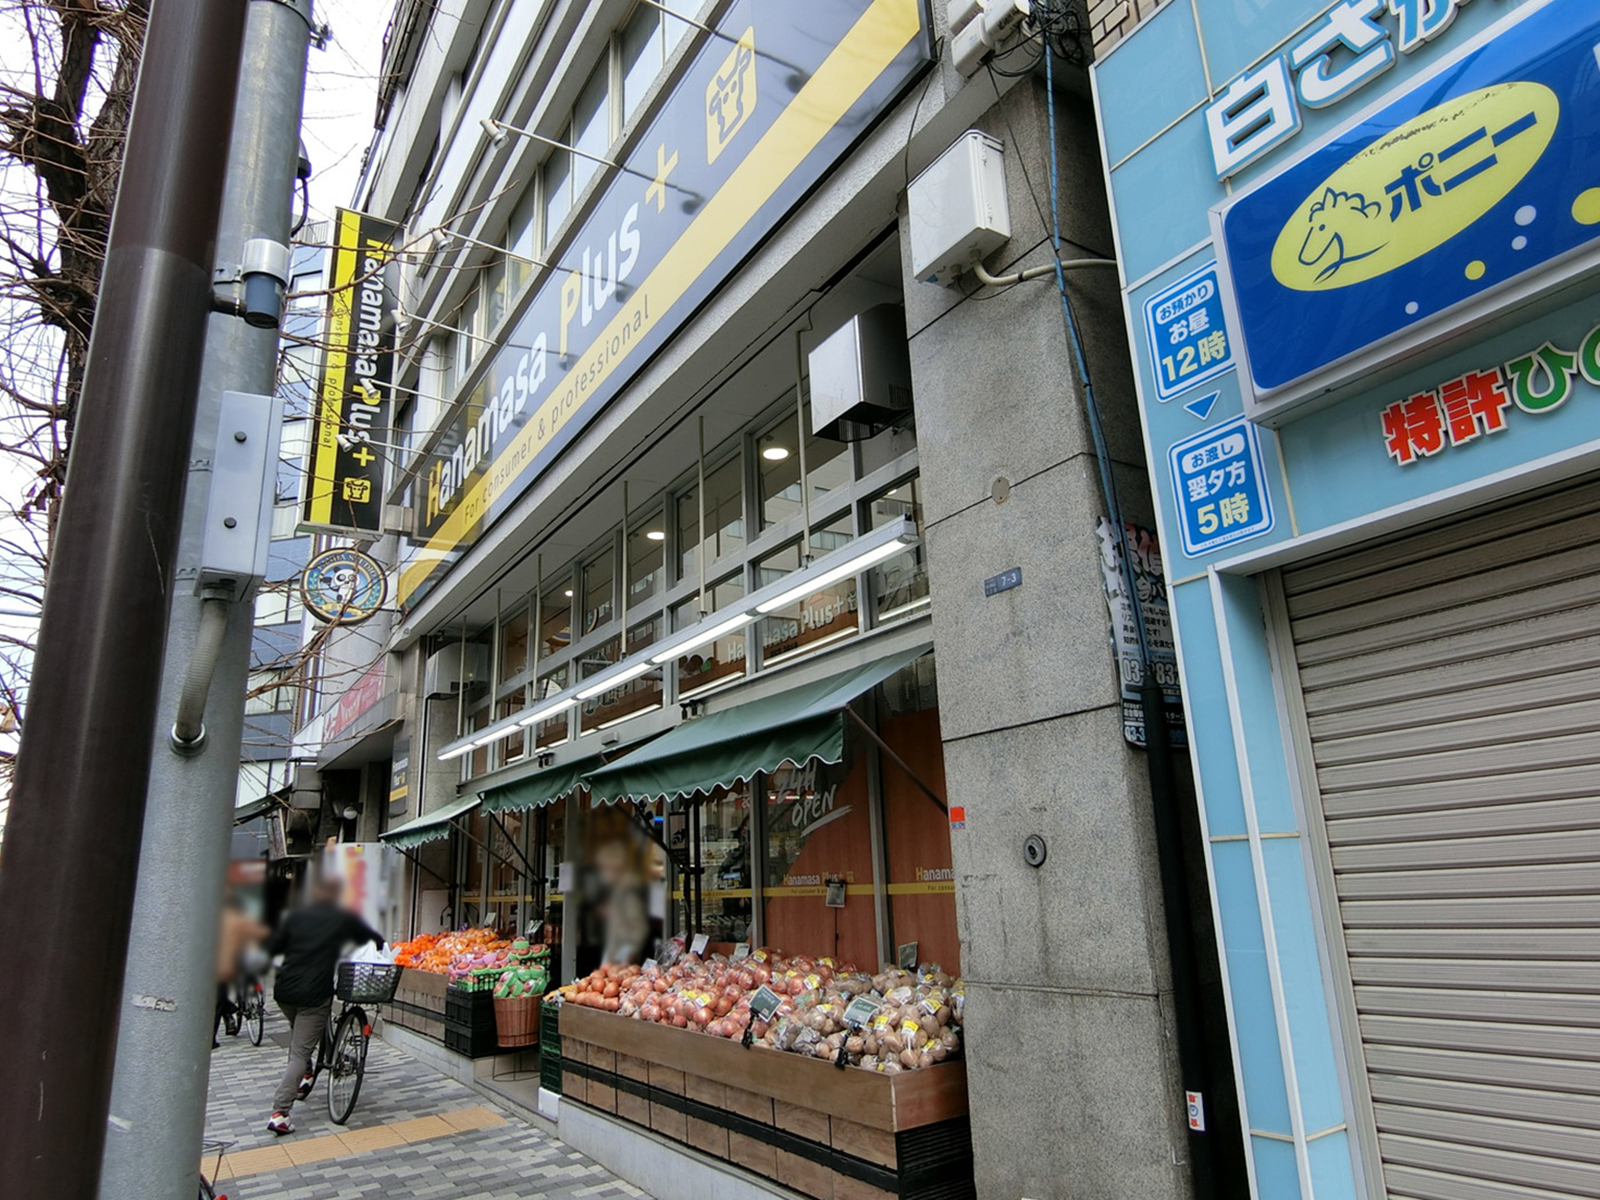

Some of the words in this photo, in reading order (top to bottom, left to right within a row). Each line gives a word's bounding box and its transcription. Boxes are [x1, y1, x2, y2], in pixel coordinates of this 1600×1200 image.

[1384, 111, 1537, 222] ポニー
[355, 238, 394, 377] Hanamasa
[1159, 285, 1208, 321] お預かり
[1169, 307, 1210, 345] お昼
[1162, 330, 1226, 381] 12時
[426, 331, 547, 527] Hanamasa
[464, 497, 479, 525] For
[483, 435, 533, 504] consumer
[537, 418, 546, 441] &
[551, 293, 649, 432] professional
[1191, 442, 1234, 468] お渡し
[1187, 460, 1246, 503] 翌夕方
[1197, 492, 1250, 535] 5時
[1001, 573, 1017, 586] 7-3
[792, 784, 837, 827] OPEN
[783, 872, 820, 886] Hanamasa
